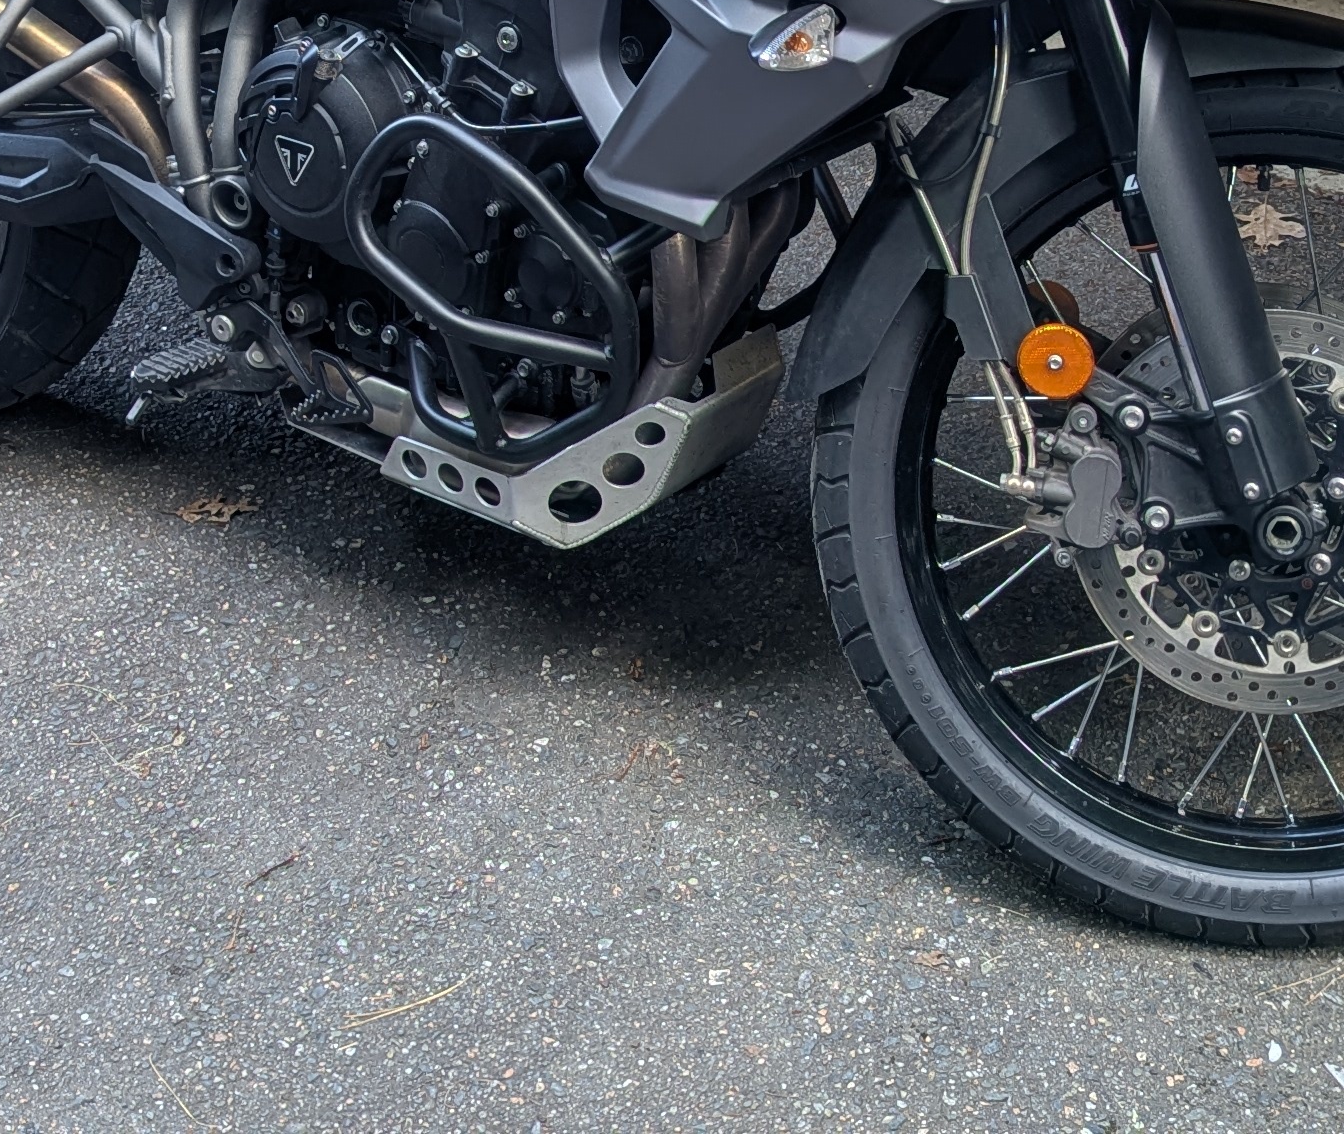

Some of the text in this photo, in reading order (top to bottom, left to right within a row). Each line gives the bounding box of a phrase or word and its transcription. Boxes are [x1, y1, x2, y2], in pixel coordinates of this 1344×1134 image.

[926, 703, 1296, 916] BATTLE WING BW-501
